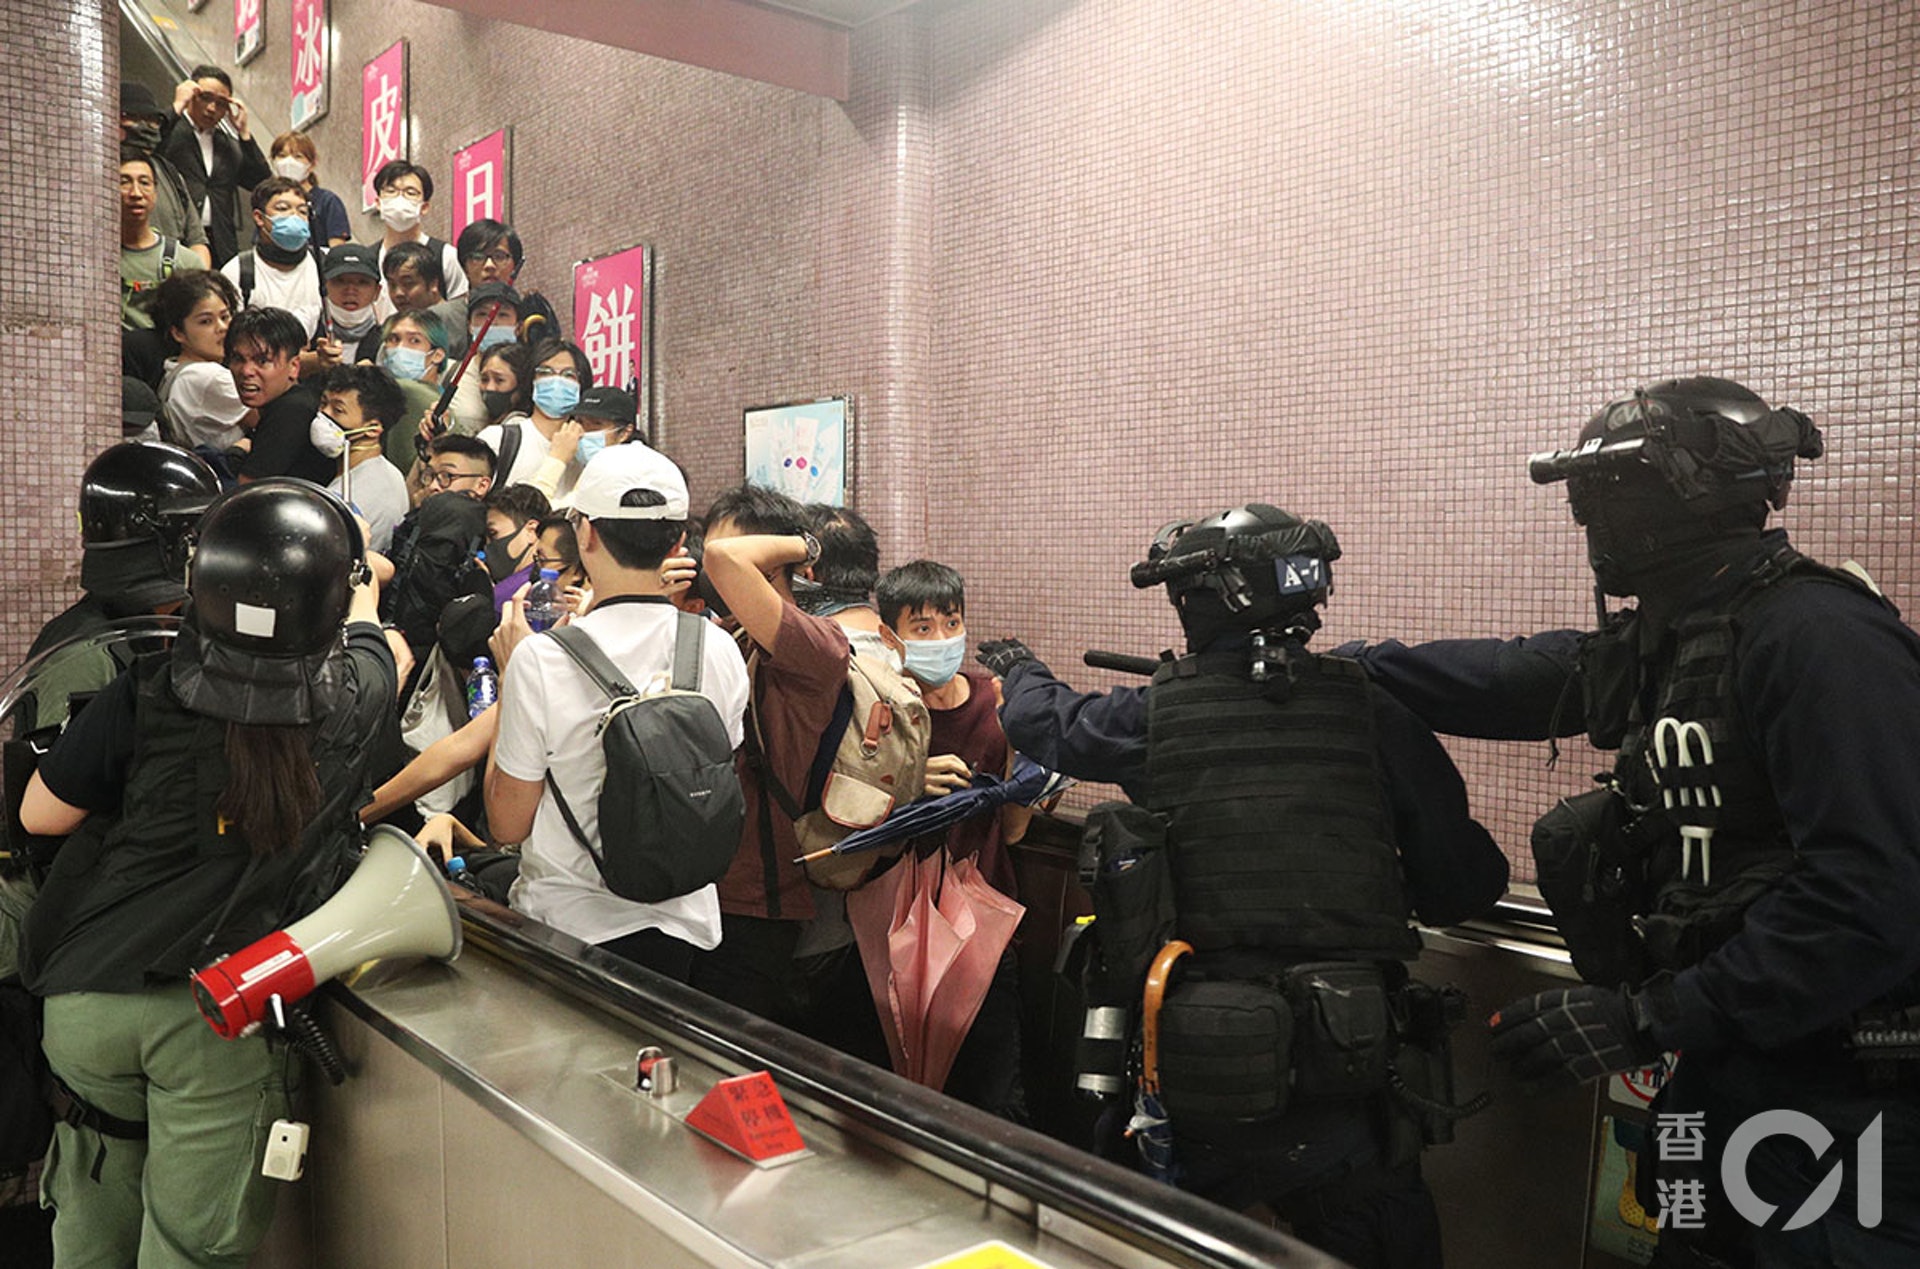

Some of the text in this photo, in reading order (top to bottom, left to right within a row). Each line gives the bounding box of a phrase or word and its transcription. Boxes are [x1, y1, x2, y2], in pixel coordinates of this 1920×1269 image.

[294, 3, 321, 87] 冰
[366, 74, 398, 174] 皮
[581, 283, 636, 394] 餅
